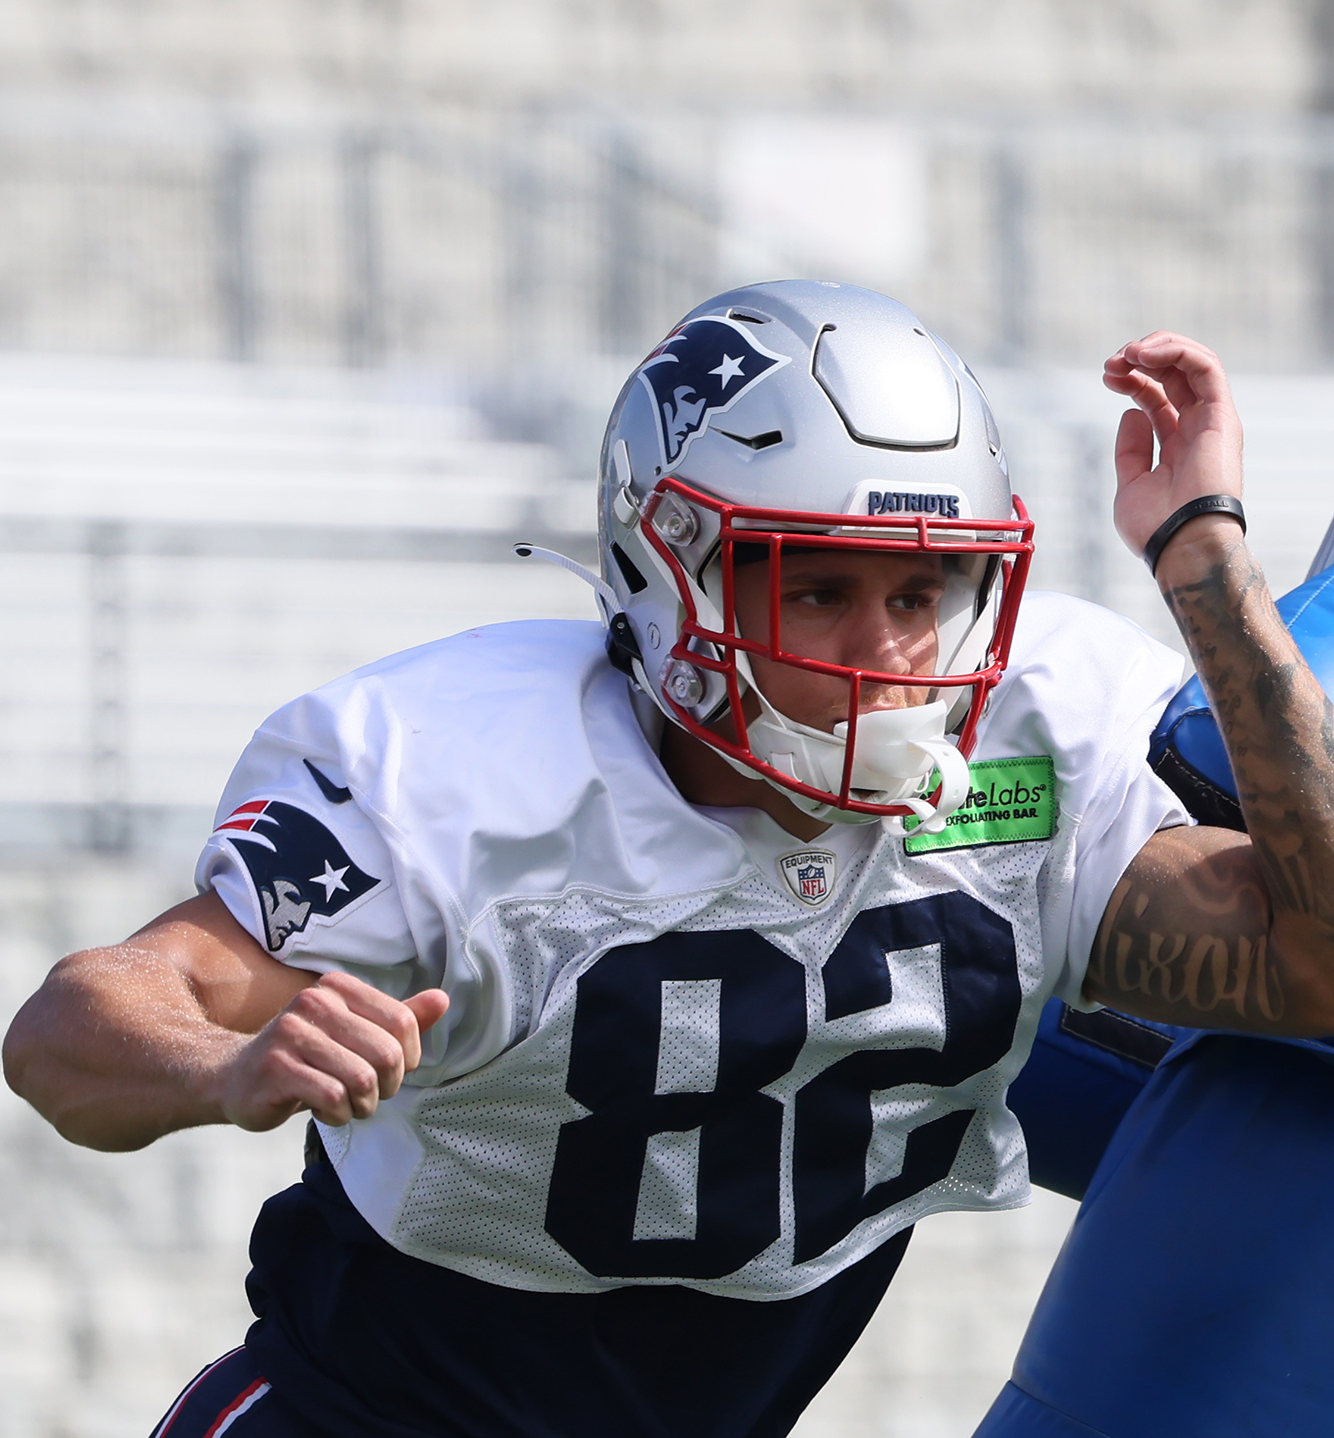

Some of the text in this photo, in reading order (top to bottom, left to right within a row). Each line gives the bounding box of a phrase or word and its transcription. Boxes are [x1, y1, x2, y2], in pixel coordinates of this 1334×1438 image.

[868, 491, 959, 518] PATRIOTS
[945, 808, 1039, 827] EXFOLIATING BAR
[785, 855, 833, 869] EQUIPMENT
[801, 879, 824, 896] NFL
[544, 889, 1022, 1280] 82
